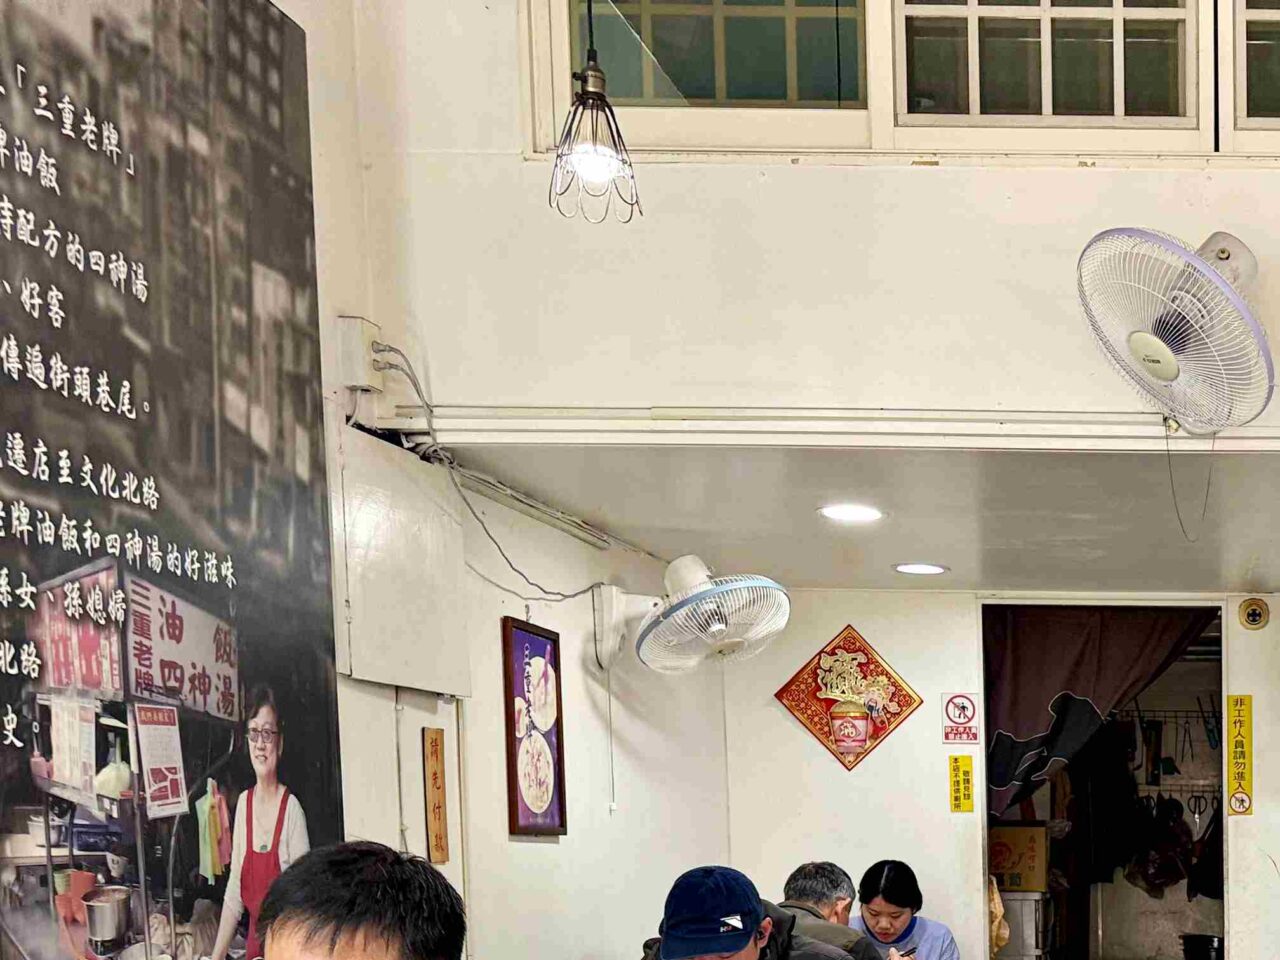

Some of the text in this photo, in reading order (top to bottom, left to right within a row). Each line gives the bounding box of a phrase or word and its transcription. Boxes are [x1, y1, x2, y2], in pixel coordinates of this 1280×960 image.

[0, 432, 160, 510] 遷店至文化北路
[0, 498, 238, 589] 牌油飯和四神湯的好滋味
[1232, 697, 1247, 792] 非工作人員請勿進入
